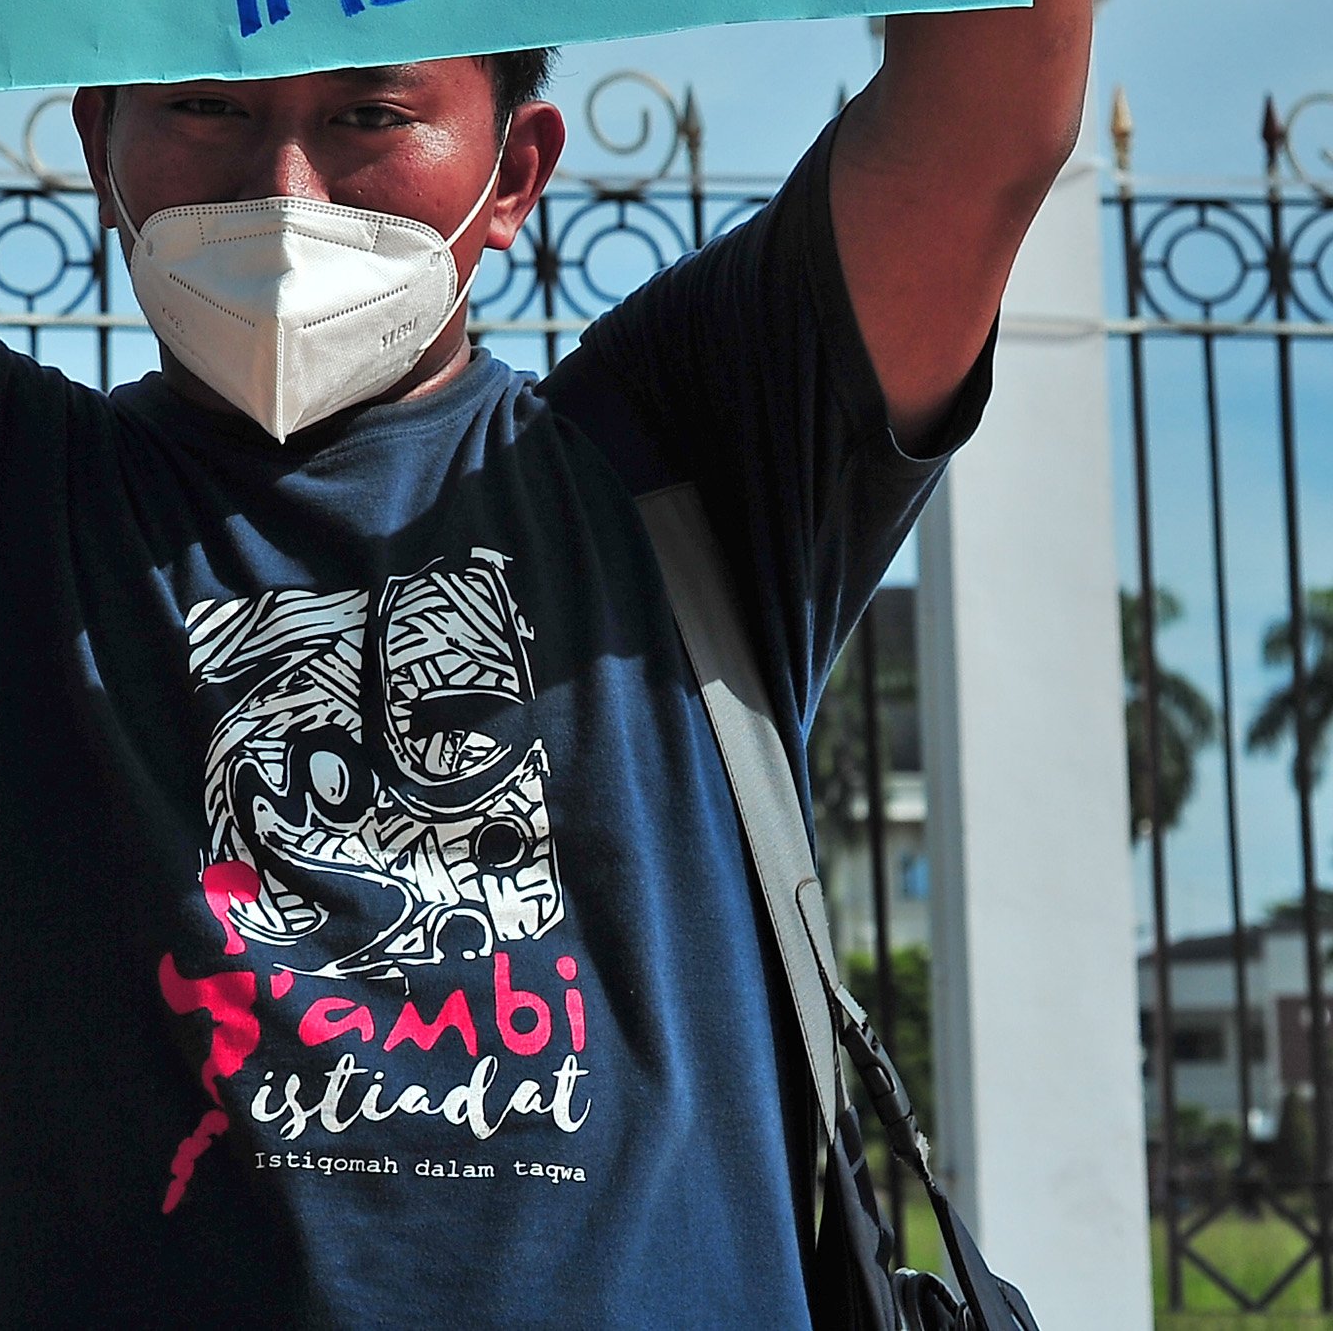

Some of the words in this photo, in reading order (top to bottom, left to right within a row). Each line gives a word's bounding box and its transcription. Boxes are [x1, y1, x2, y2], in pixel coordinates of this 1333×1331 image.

[251, 1053, 592, 1140] istiadat
[255, 1151, 399, 1177] Istiqomah
[415, 1159, 496, 1179] dalam
[513, 1159, 587, 1184] taqwa
